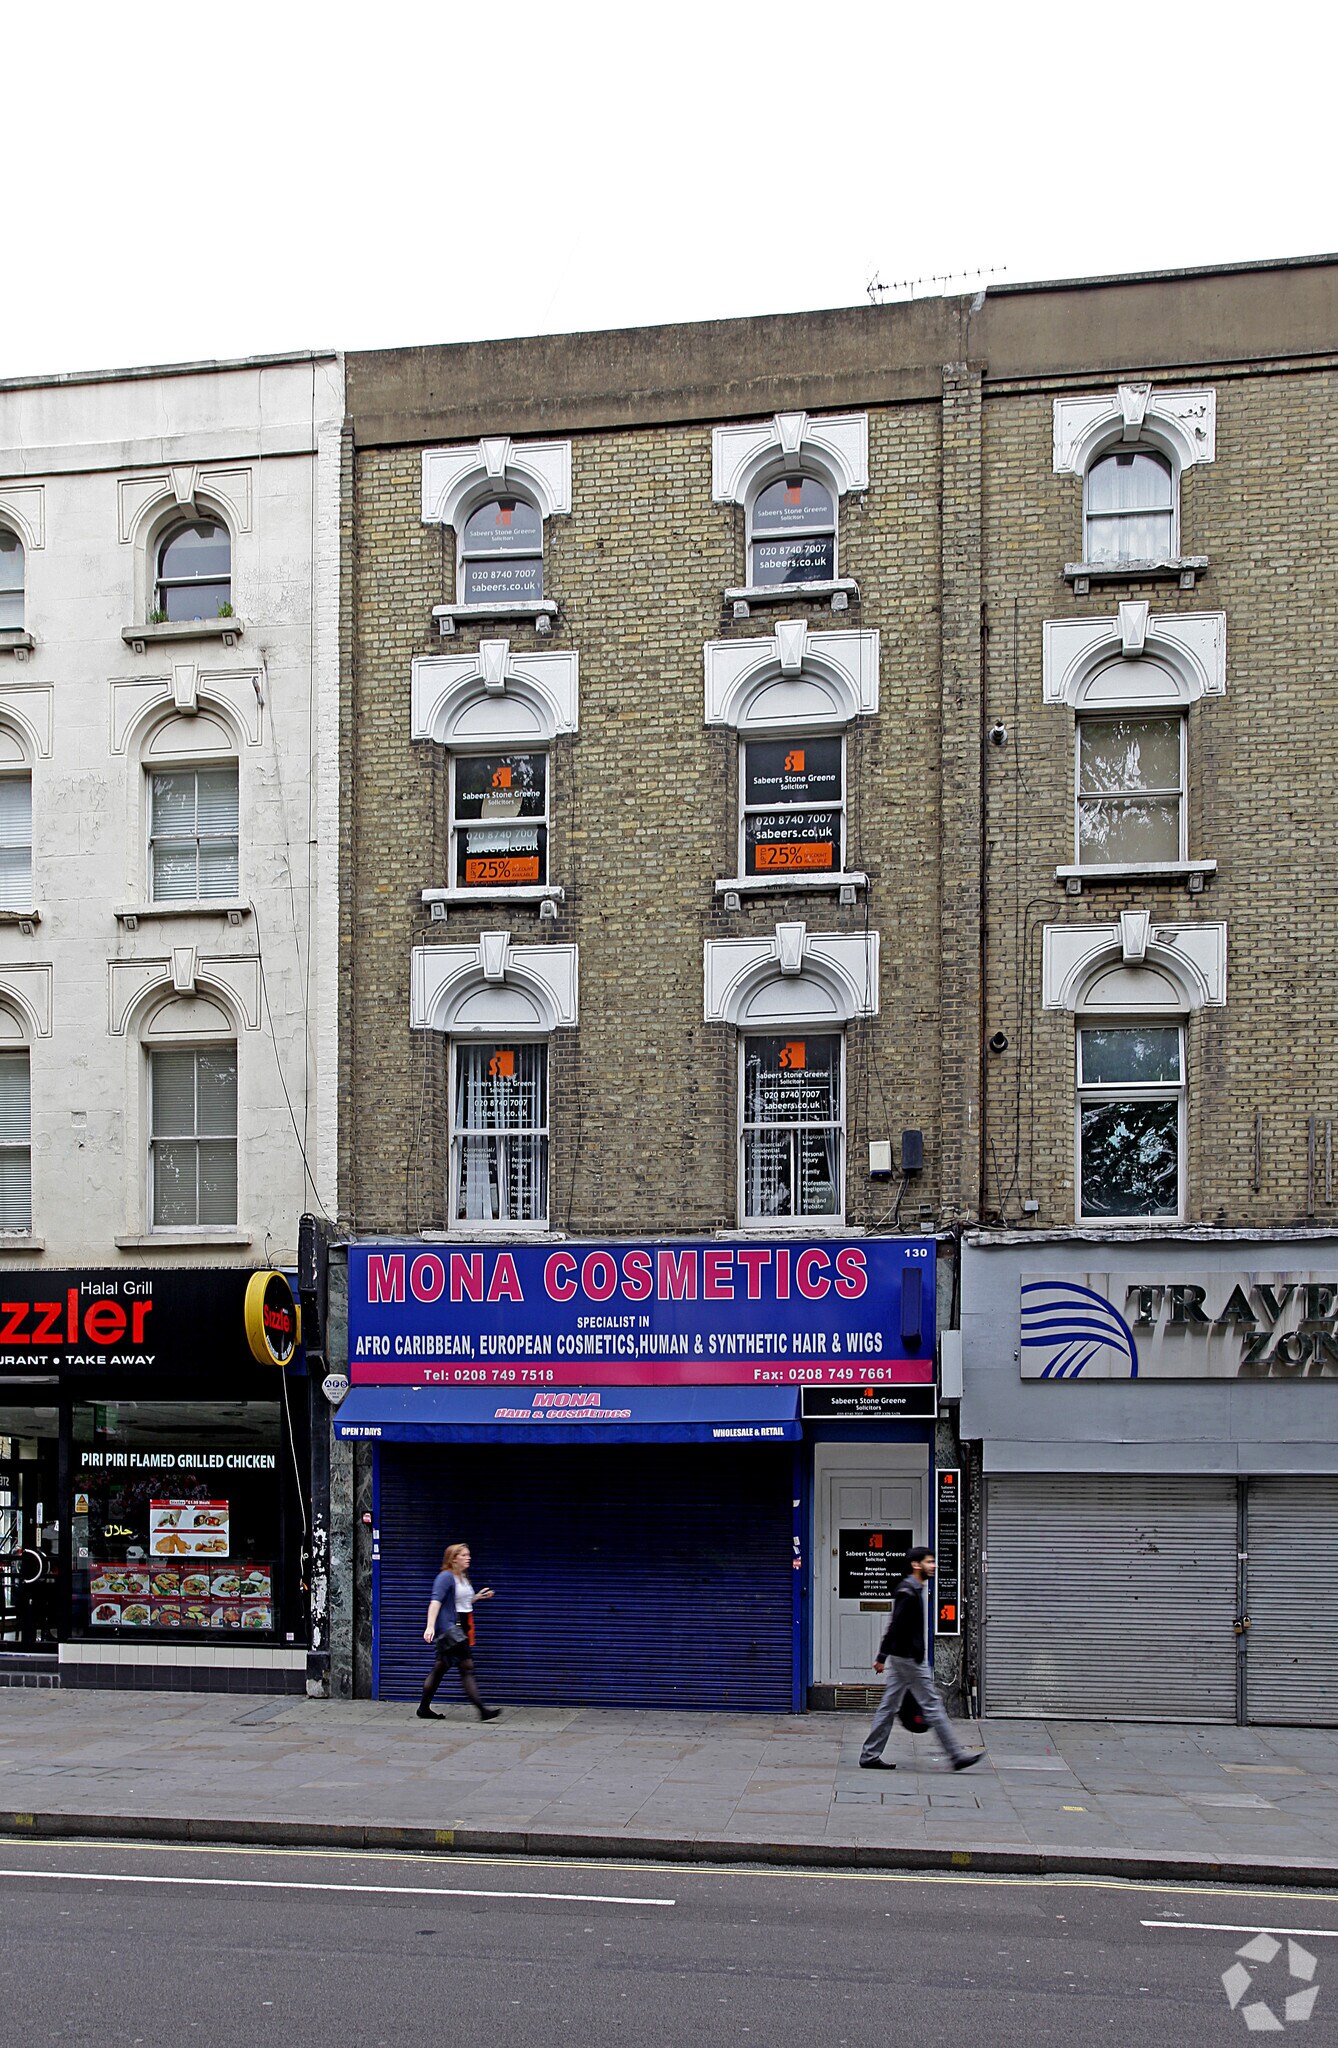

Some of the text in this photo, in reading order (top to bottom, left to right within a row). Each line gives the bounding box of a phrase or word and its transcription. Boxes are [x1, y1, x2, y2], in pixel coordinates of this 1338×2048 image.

[760, 545, 827, 556] 020 8740 7007
[760, 557, 827, 569] sabeers.co.uk
[472, 569, 536, 580] 020 8740 7007
[471, 581, 535, 592] sabeers.co.uk
[754, 774, 836, 784] Sabeers Stone Greene
[462, 789, 540, 800] Sabeers Stone Greene
[756, 814, 832, 825] 020 8740 7007
[466, 829, 539, 841] 020 8740 7007
[756, 826, 832, 839] sabeers.co.uk
[768, 846, 803, 865] 25%
[477, 860, 511, 879] 25%
[756, 1071, 782, 1079] Sabeers
[764, 1091, 778, 1099] 020
[801, 1090, 820, 1098] 7007
[764, 1101, 820, 1110] sabeers.co.uk
[474, 1109, 528, 1117] sabeers.co.uk
[904, 1248, 928, 1258] 130
[367, 1247, 868, 1303] MONA COSMETICS
[80, 1280, 153, 1295] Halal Grill
[1126, 1283, 1338, 1324] TRAVE
[0, 1288, 153, 1345] zzler
[577, 1315, 650, 1329] SPECIALIST IN
[355, 1335, 391, 1356] AFRO
[394, 1334, 475, 1360] CARIBBEAN,
[480, 1334, 552, 1356] EUROPEAN
[693, 1334, 704, 1354] &
[708, 1333, 788, 1355] SYNTHETIC
[792, 1333, 826, 1354] HAIR
[831, 1332, 841, 1353] &
[846, 1331, 883, 1353] WIGS
[0, 1355, 155, 1365] RANT TAKE AWAY
[424, 1369, 554, 1381] Tel: 0208 749 7518
[753, 1367, 893, 1380] Fax: 0208 749 7661
[532, 1392, 601, 1407] MONA
[494, 1408, 632, 1419] HAIR & COSMETICS
[341, 1427, 382, 1436] OPEN 7 DAYS
[713, 1426, 784, 1438] WHOLESALE & RETAIL
[81, 1452, 275, 1468] PIRI PIRI FLAMED GRILLED CHICKEN
[104, 1524, 133, 1538] حلال
